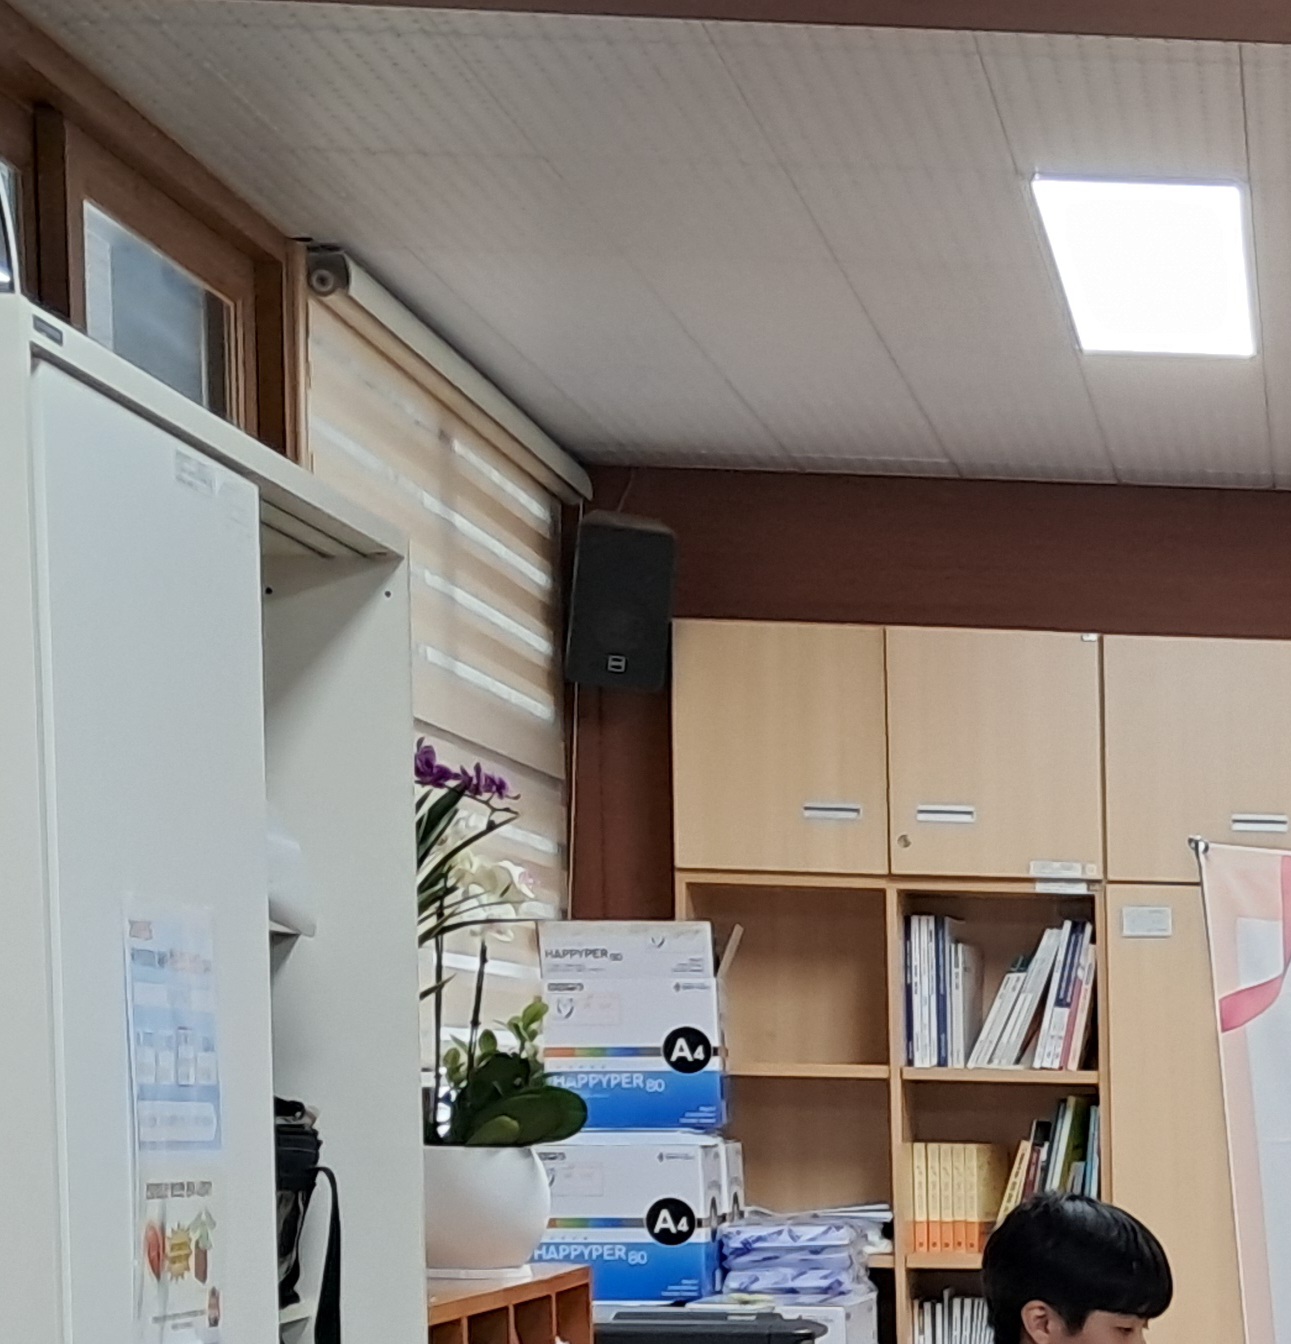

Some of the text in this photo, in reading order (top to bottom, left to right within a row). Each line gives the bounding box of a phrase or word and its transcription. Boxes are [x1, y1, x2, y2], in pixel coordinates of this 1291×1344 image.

[544, 948, 609, 959] HAPPYPER
[669, 1036, 706, 1063] A4
[645, 1079, 666, 1092] 80
[653, 1208, 690, 1235] A4
[534, 1244, 648, 1266] HAPPYPER 80
